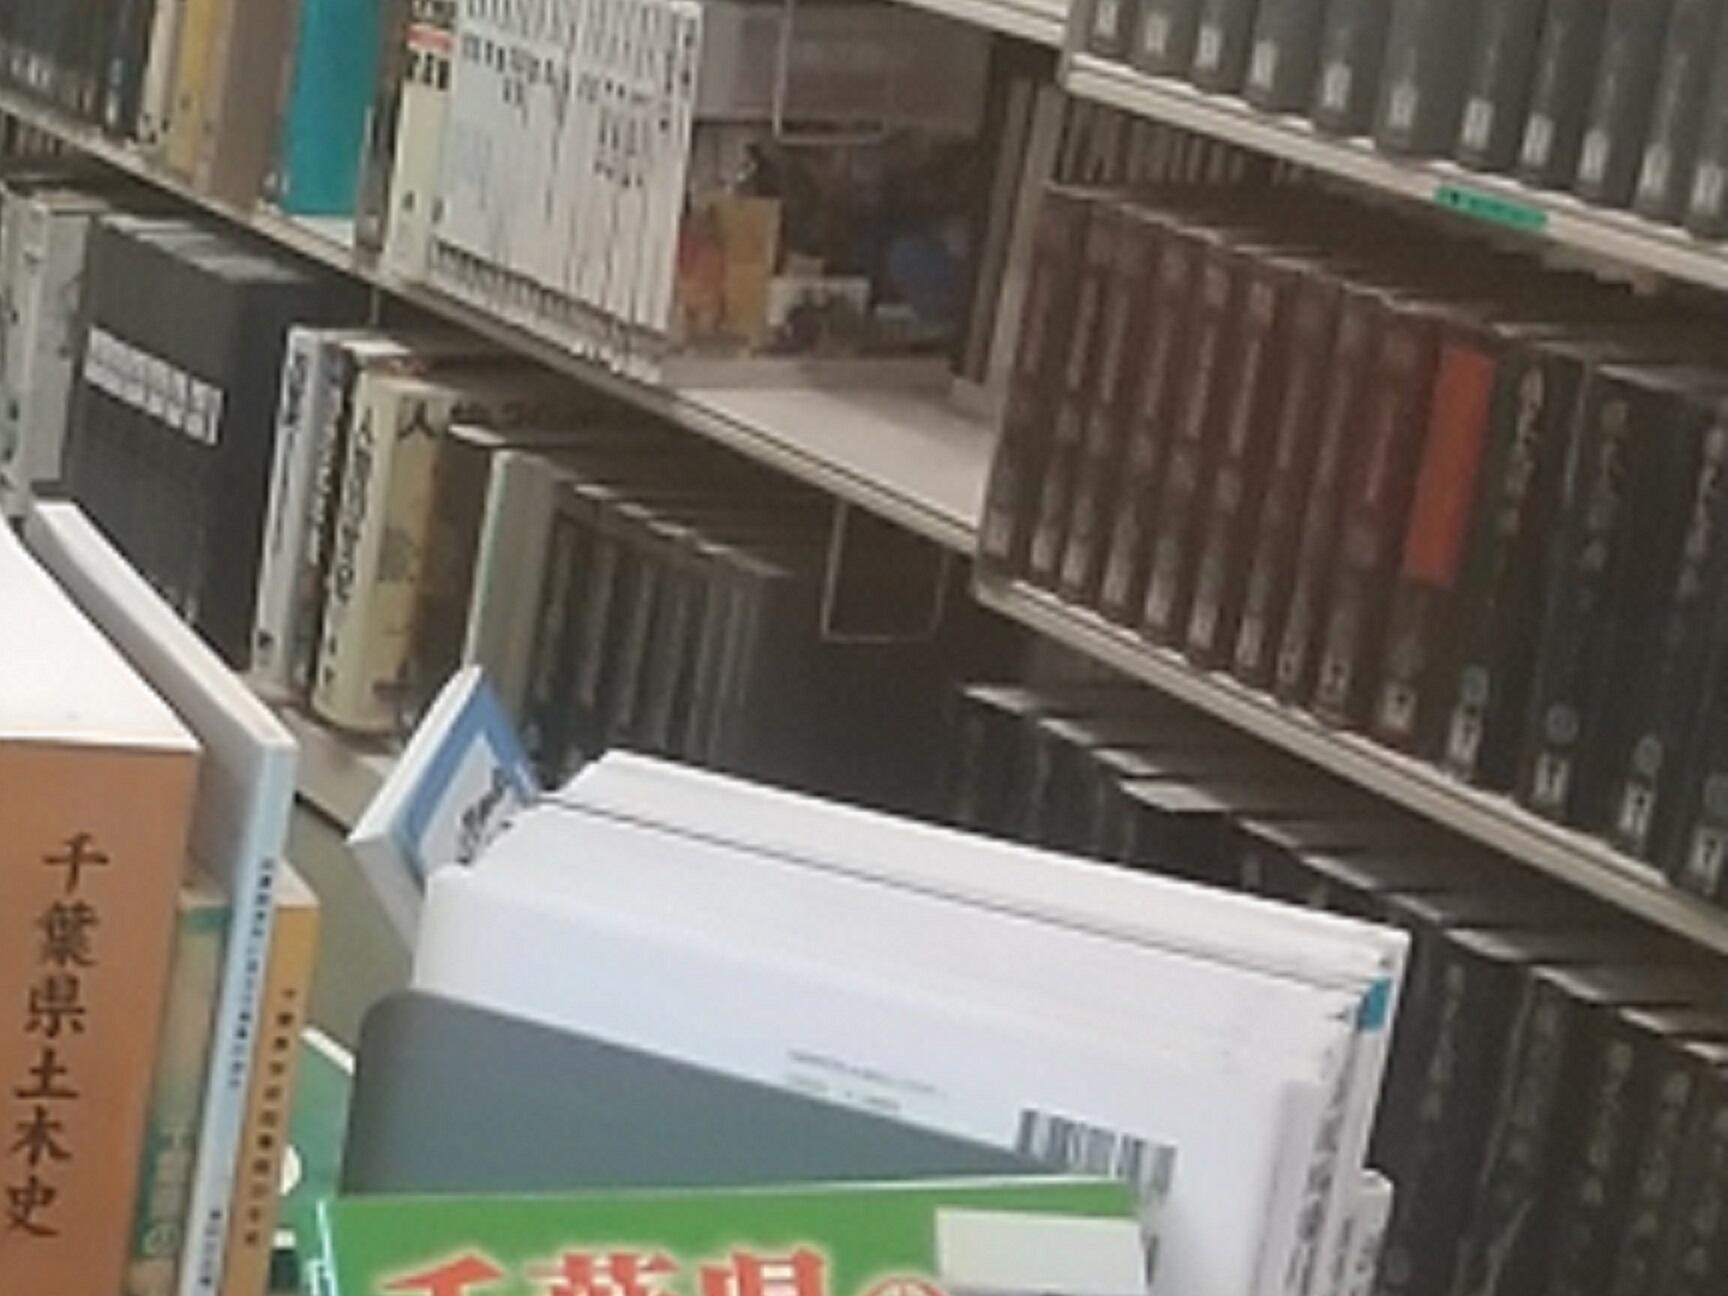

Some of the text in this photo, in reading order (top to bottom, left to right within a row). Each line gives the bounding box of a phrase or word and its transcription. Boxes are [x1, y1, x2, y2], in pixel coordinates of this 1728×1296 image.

[3, 834, 109, 1240] 千葉県土木史
